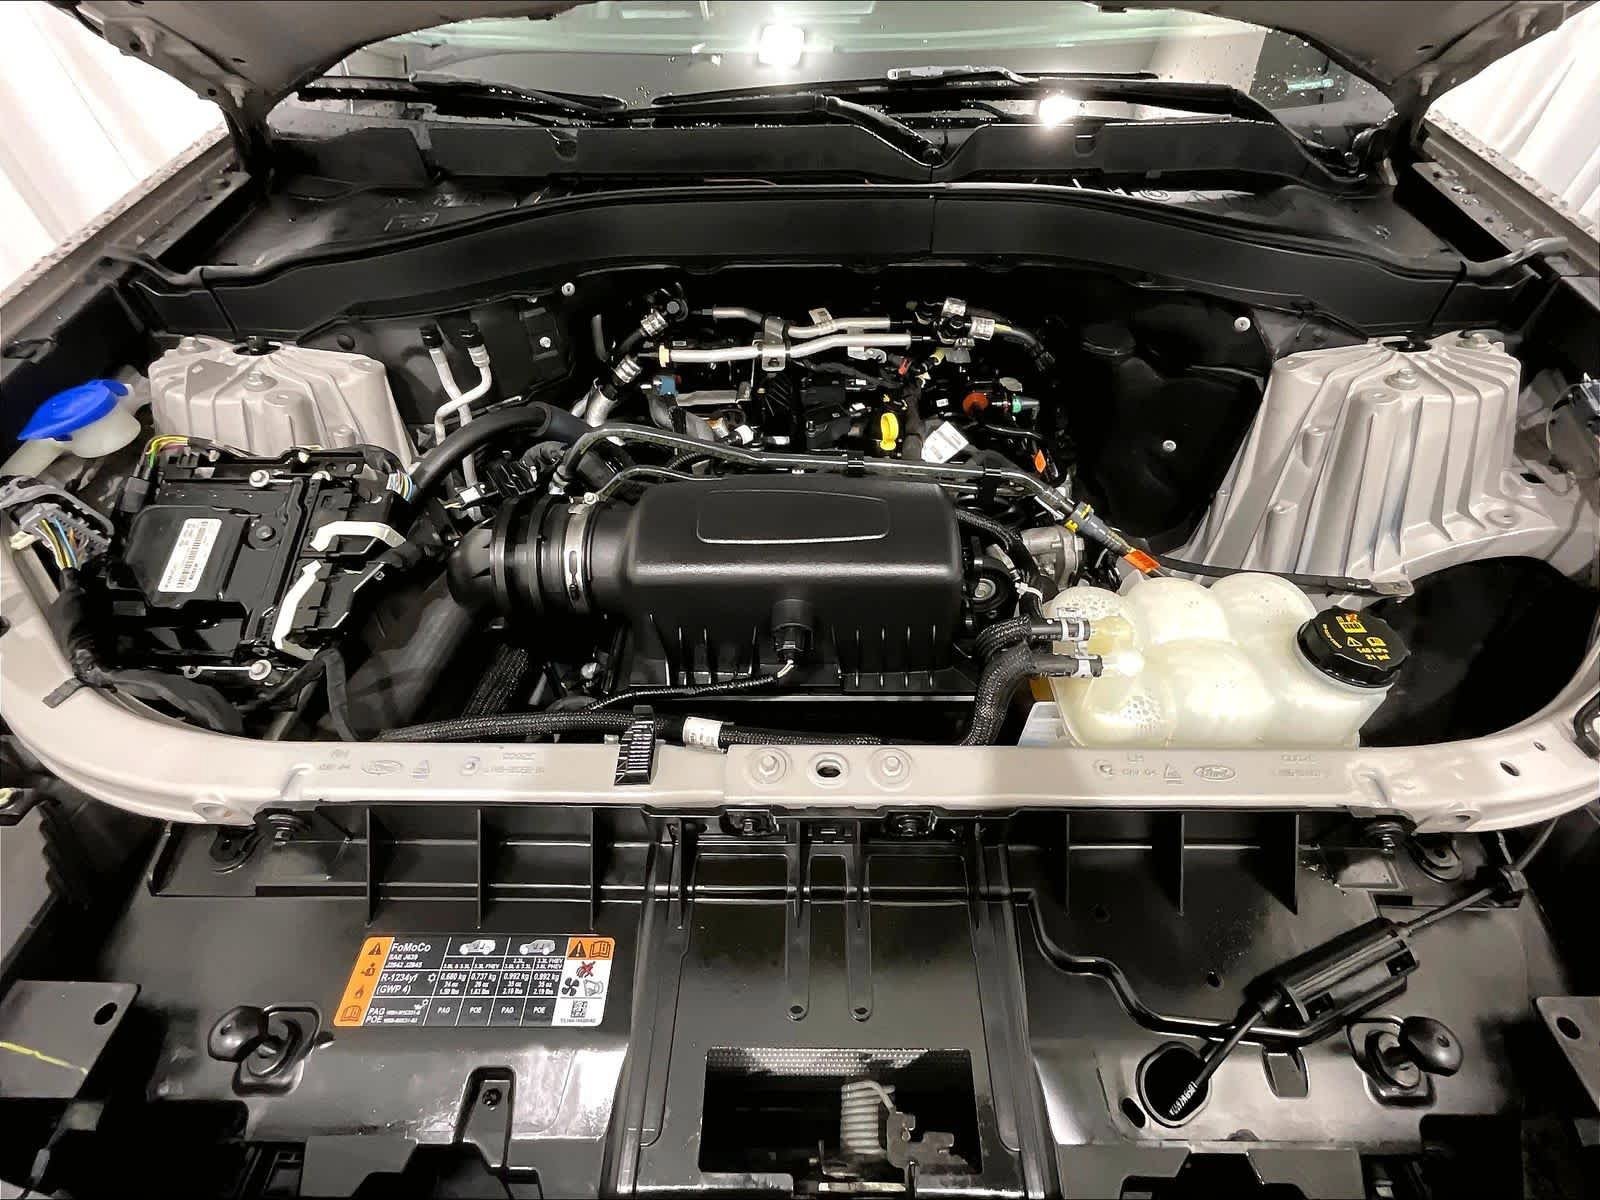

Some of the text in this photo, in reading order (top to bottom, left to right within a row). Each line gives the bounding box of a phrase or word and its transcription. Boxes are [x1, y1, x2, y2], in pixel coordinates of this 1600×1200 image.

[391, 942, 431, 953] FoMoCo
[380, 973, 418, 983] R-1234yf
[458, 973, 467, 982] kg
[488, 973, 497, 982] kg
[521, 973, 529, 981] kg
[551, 973, 559, 982] kg
[376, 985, 411, 995] (GWP 4)
[365, 1015, 383, 1023] POE
